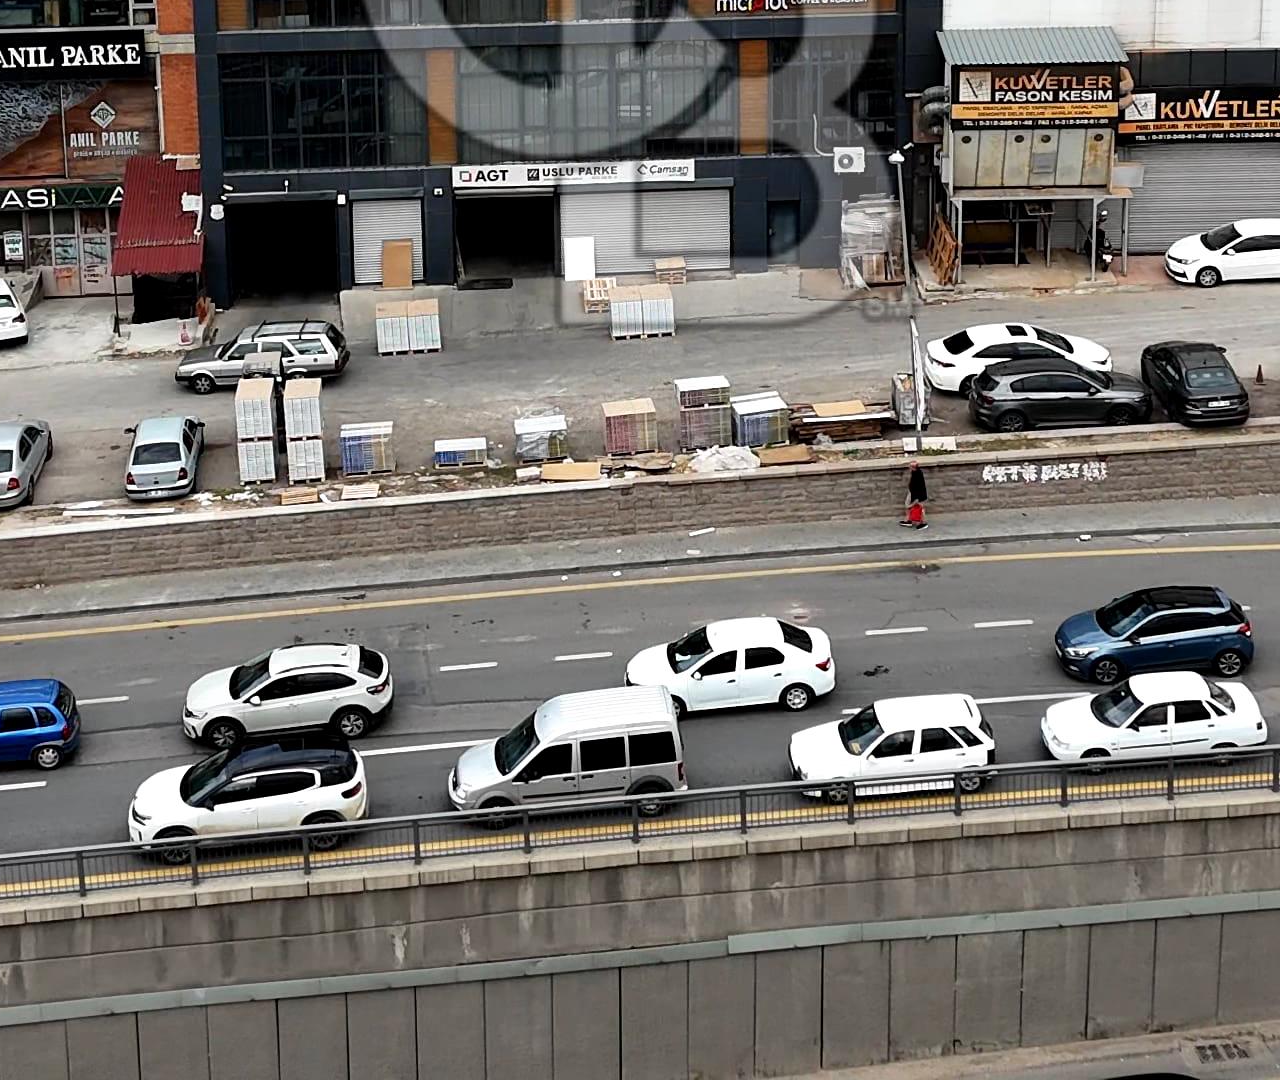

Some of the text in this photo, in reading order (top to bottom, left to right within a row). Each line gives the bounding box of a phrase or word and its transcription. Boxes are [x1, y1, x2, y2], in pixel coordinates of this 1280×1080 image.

[61, 44, 141, 66] PARKE
[994, 90, 1053, 101] FASON
[70, 131, 140, 148] ANIL PARKE
[475, 169, 509, 183] AGT
[542, 167, 575, 177] USLU
[578, 165, 618, 176] PARKE
